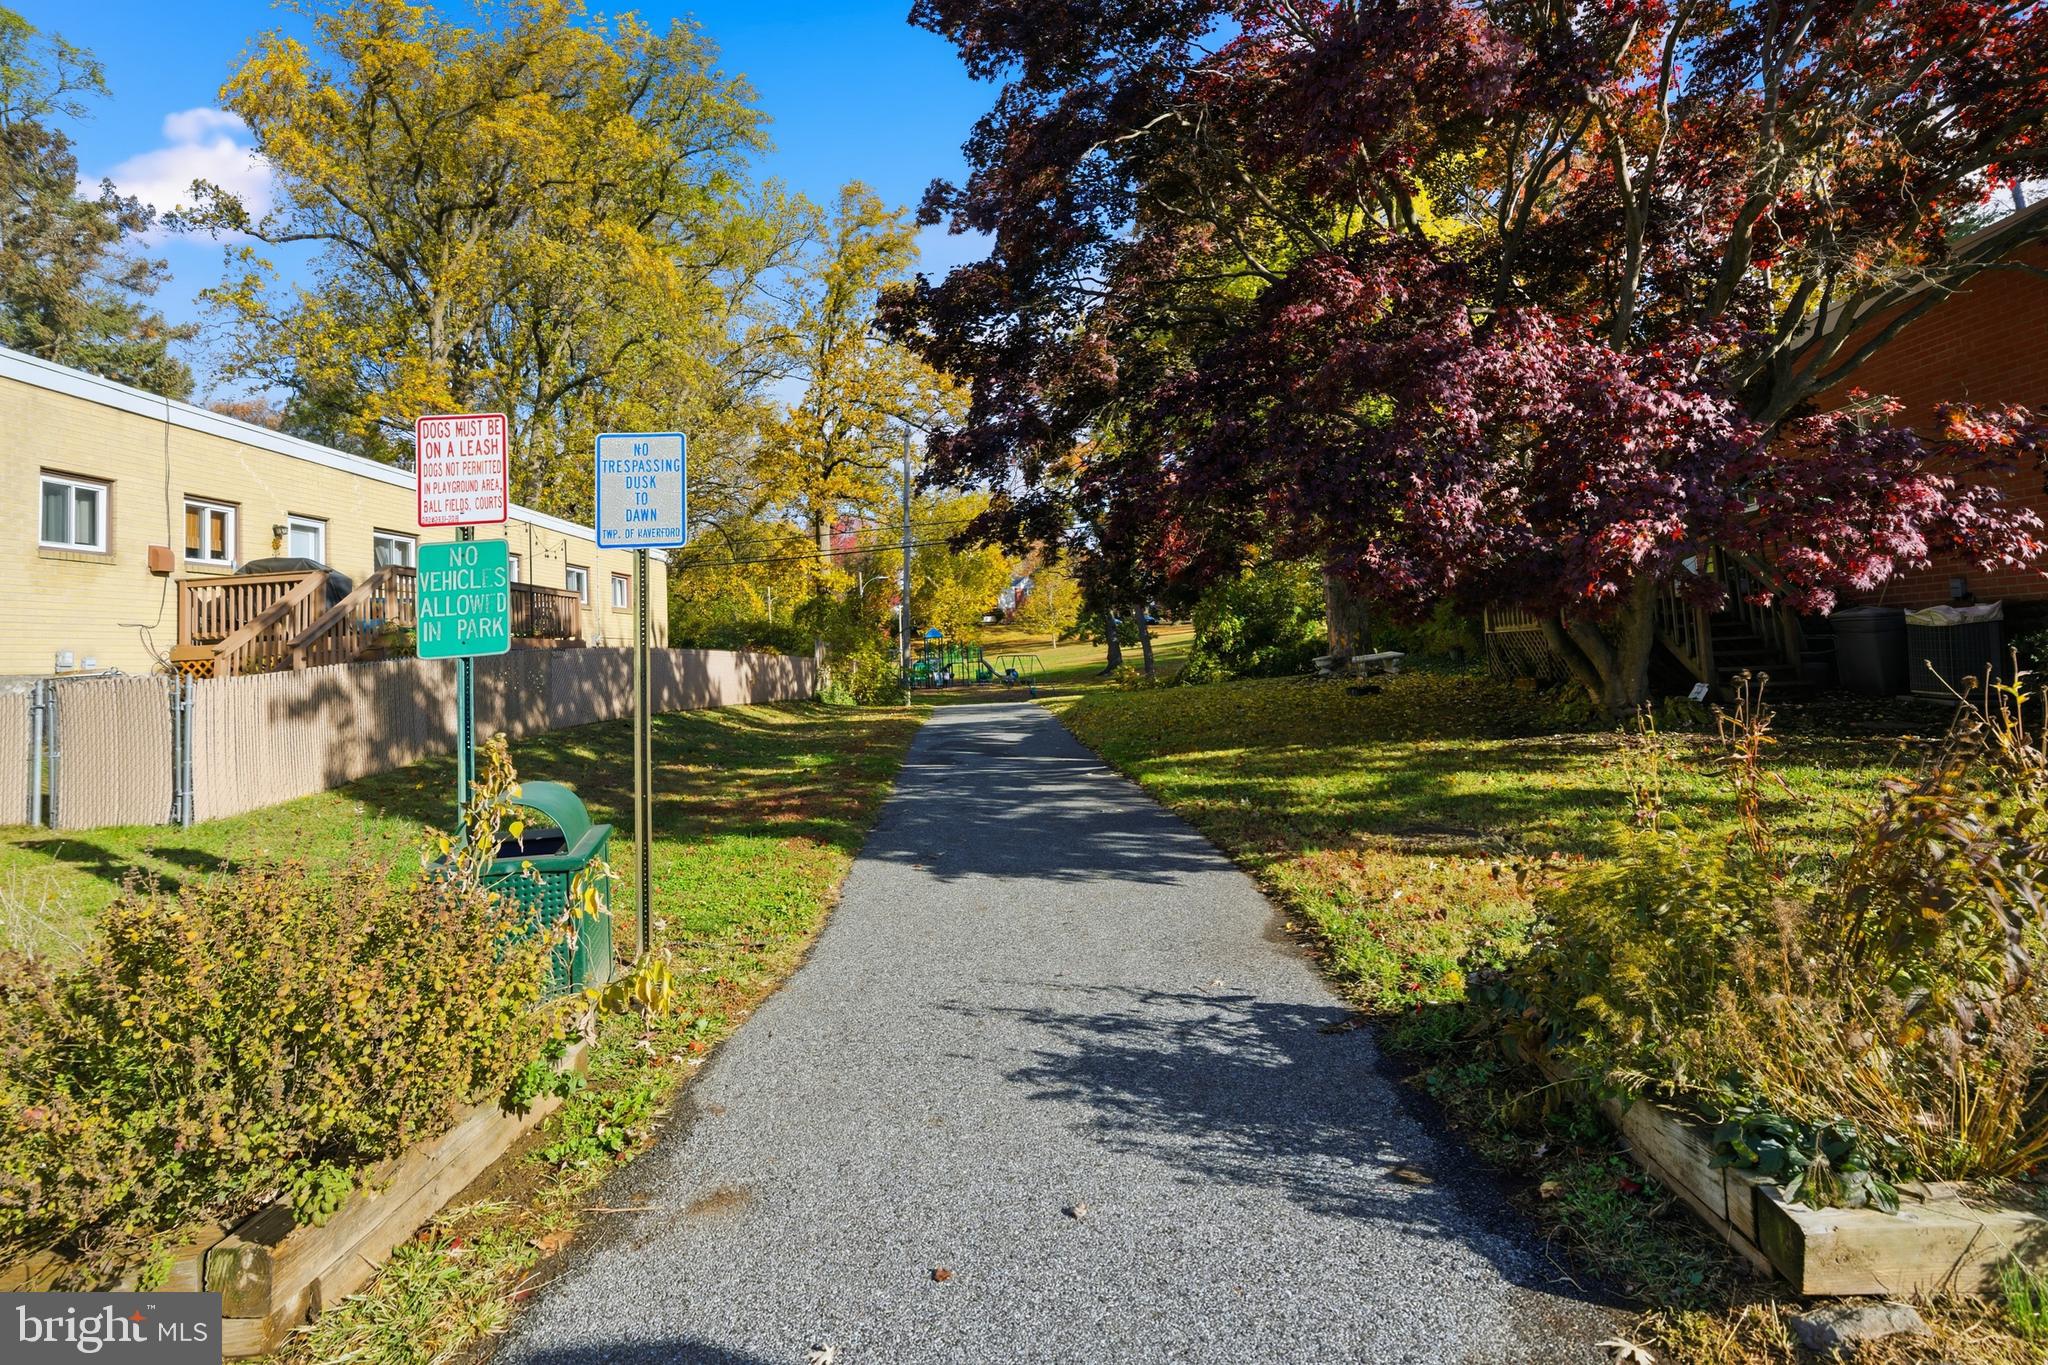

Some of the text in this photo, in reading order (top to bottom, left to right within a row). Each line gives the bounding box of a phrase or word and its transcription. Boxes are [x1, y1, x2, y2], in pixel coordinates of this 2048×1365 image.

[423, 419, 501, 439] DOGS MUST BE
[425, 439, 498, 459] ON A LEASH
[634, 443, 649, 456] NO
[423, 460, 501, 478] DOGS NOT PERMITTED
[602, 459, 680, 473] TRESPASSING
[424, 479, 503, 494] IN PLAYGROUND AREA,
[626, 475, 656, 489] DUSK
[424, 500, 442, 513] BALL
[475, 496, 503, 510] COURTS
[635, 492, 648, 505] TO
[626, 508, 657, 522] DAWN
[603, 527, 681, 539] TWP. OF HAVERFORD
[449, 545, 478, 567] NO
[420, 566, 506, 592] VEHICLES
[423, 616, 504, 642] IN PARK
